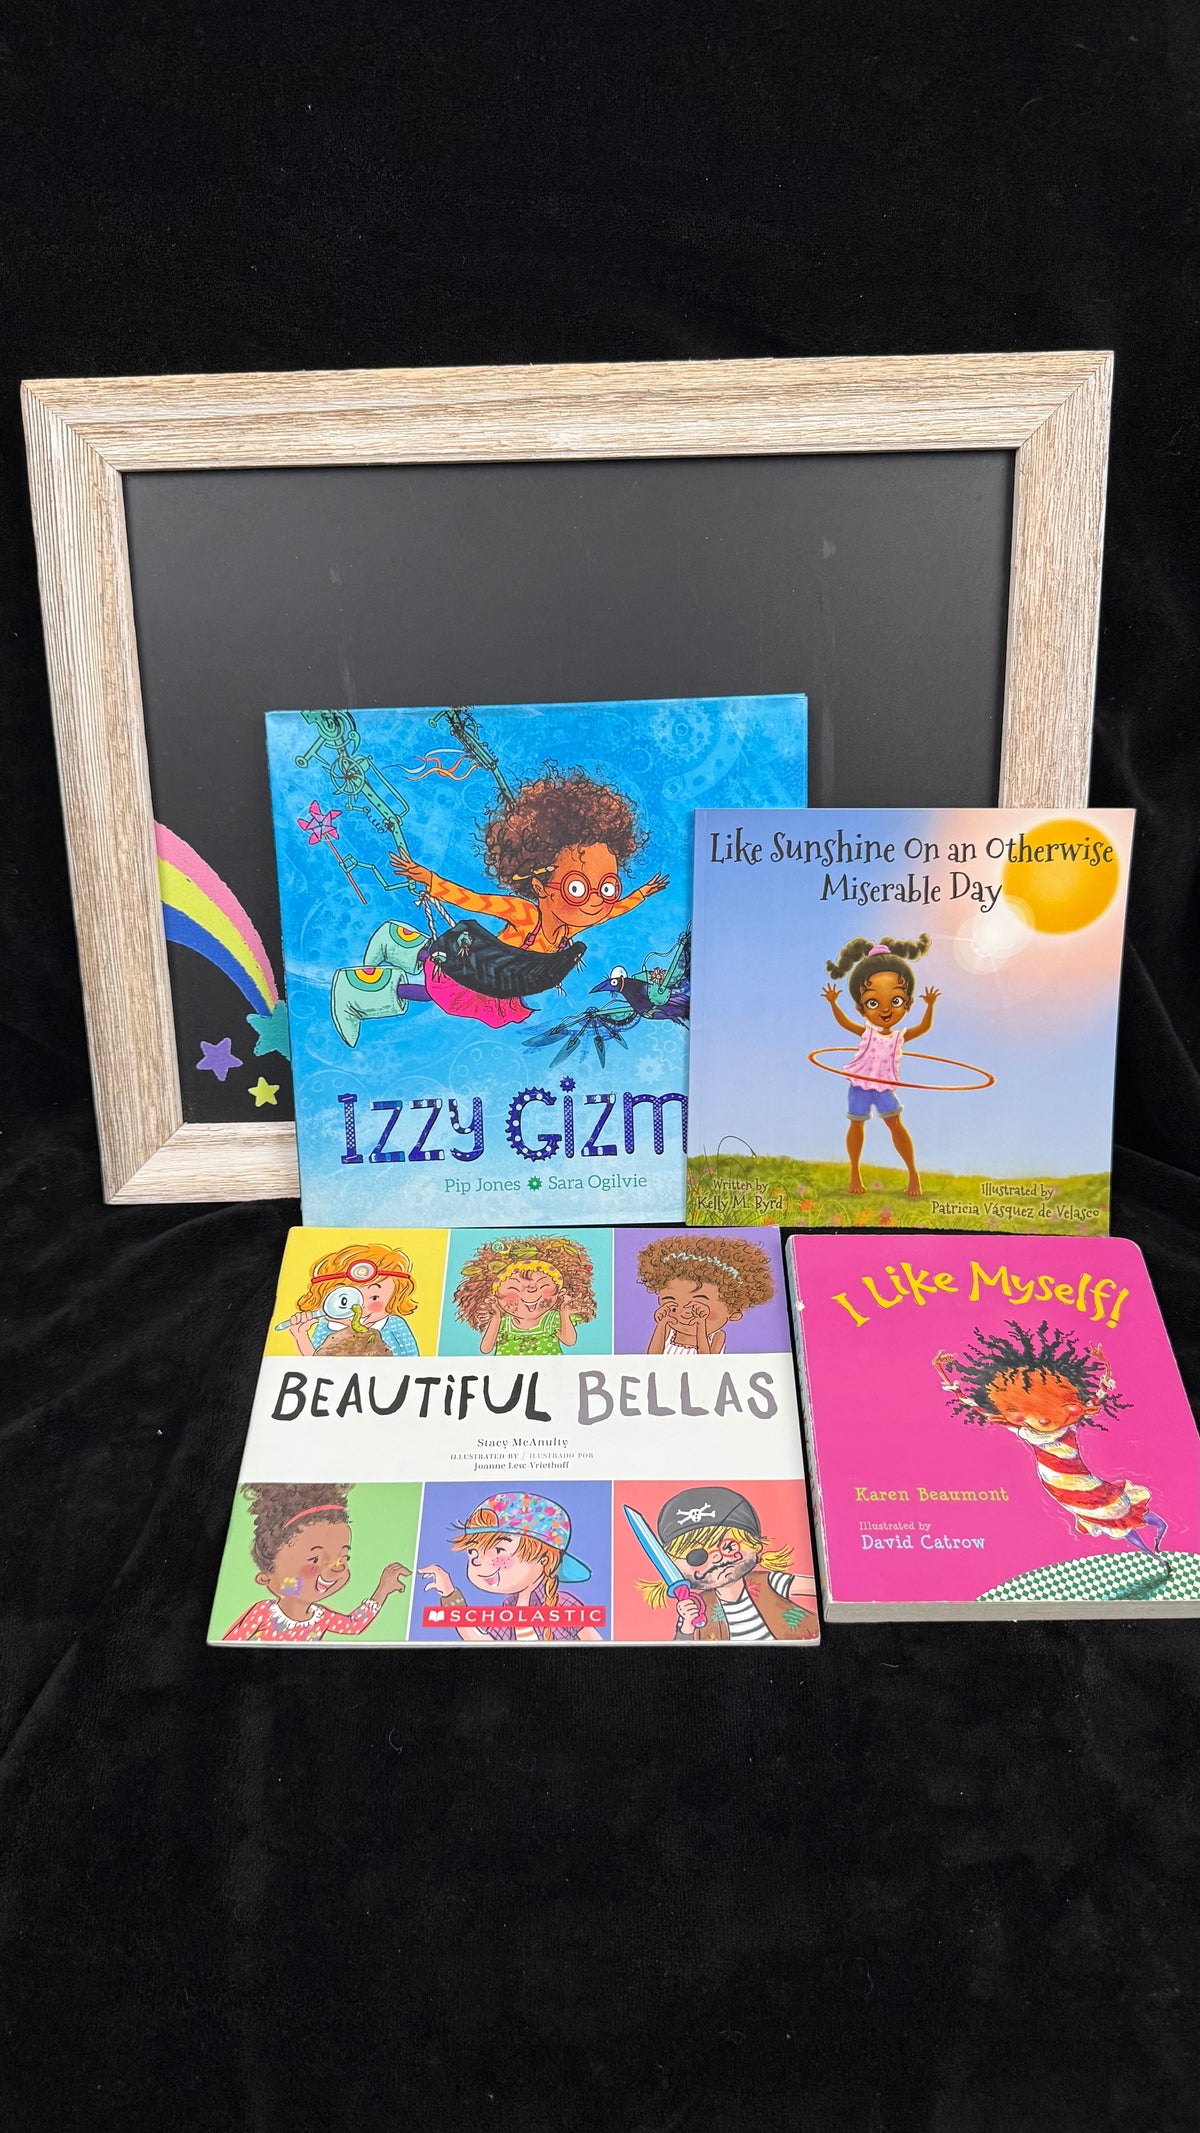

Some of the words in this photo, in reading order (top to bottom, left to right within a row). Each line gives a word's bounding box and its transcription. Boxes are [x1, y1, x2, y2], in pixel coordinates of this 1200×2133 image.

[710, 828, 763, 866] Like
[770, 829, 895, 867] Sunshine
[904, 837, 940, 861] On
[947, 842, 977, 863] an
[985, 833, 1114, 867] Otherwise
[820, 872, 941, 906] Miserable
[949, 871, 1002, 913] Day
[337, 1093, 485, 1164] Izzy
[505, 1076, 688, 1162] Gizm
[444, 1178, 471, 1194] Pip
[475, 1177, 521, 1192] Jones
[548, 1176, 584, 1190] Sara
[587, 1175, 648, 1191] Ogilvie
[713, 1179, 752, 1191] Written
[755, 1179, 768, 1193] by
[981, 1183, 1037, 1196] Illustrated
[1040, 1184, 1055, 1200] by
[697, 1196, 729, 1213] Kelly
[732, 1196, 750, 1209] M.
[755, 1196, 783, 1214] Byrd
[931, 1201, 979, 1215] Patricia
[983, 1202, 1034, 1219] Vásquez
[1038, 1204, 1051, 1218] de
[1056, 1204, 1099, 1221] Velasco
[831, 1292, 870, 1327] I
[861, 1262, 959, 1306] Like
[969, 1261, 1129, 1328] Myself!
[577, 1370, 779, 1426] BELLAS
[477, 1438, 509, 1449] Stacy
[512, 1437, 569, 1448] McAnulty
[474, 1462, 506, 1471] Joanne
[508, 1461, 569, 1469] Lew-Vriethoff
[855, 1487, 910, 1501] Karen
[917, 1487, 1009, 1502] Beaumont
[859, 1521, 915, 1531] Illustrated
[918, 1521, 931, 1532] by
[861, 1534, 914, 1550] David
[920, 1534, 986, 1549] Catrow
[450, 1609, 602, 1622] SCHOLASTIC
